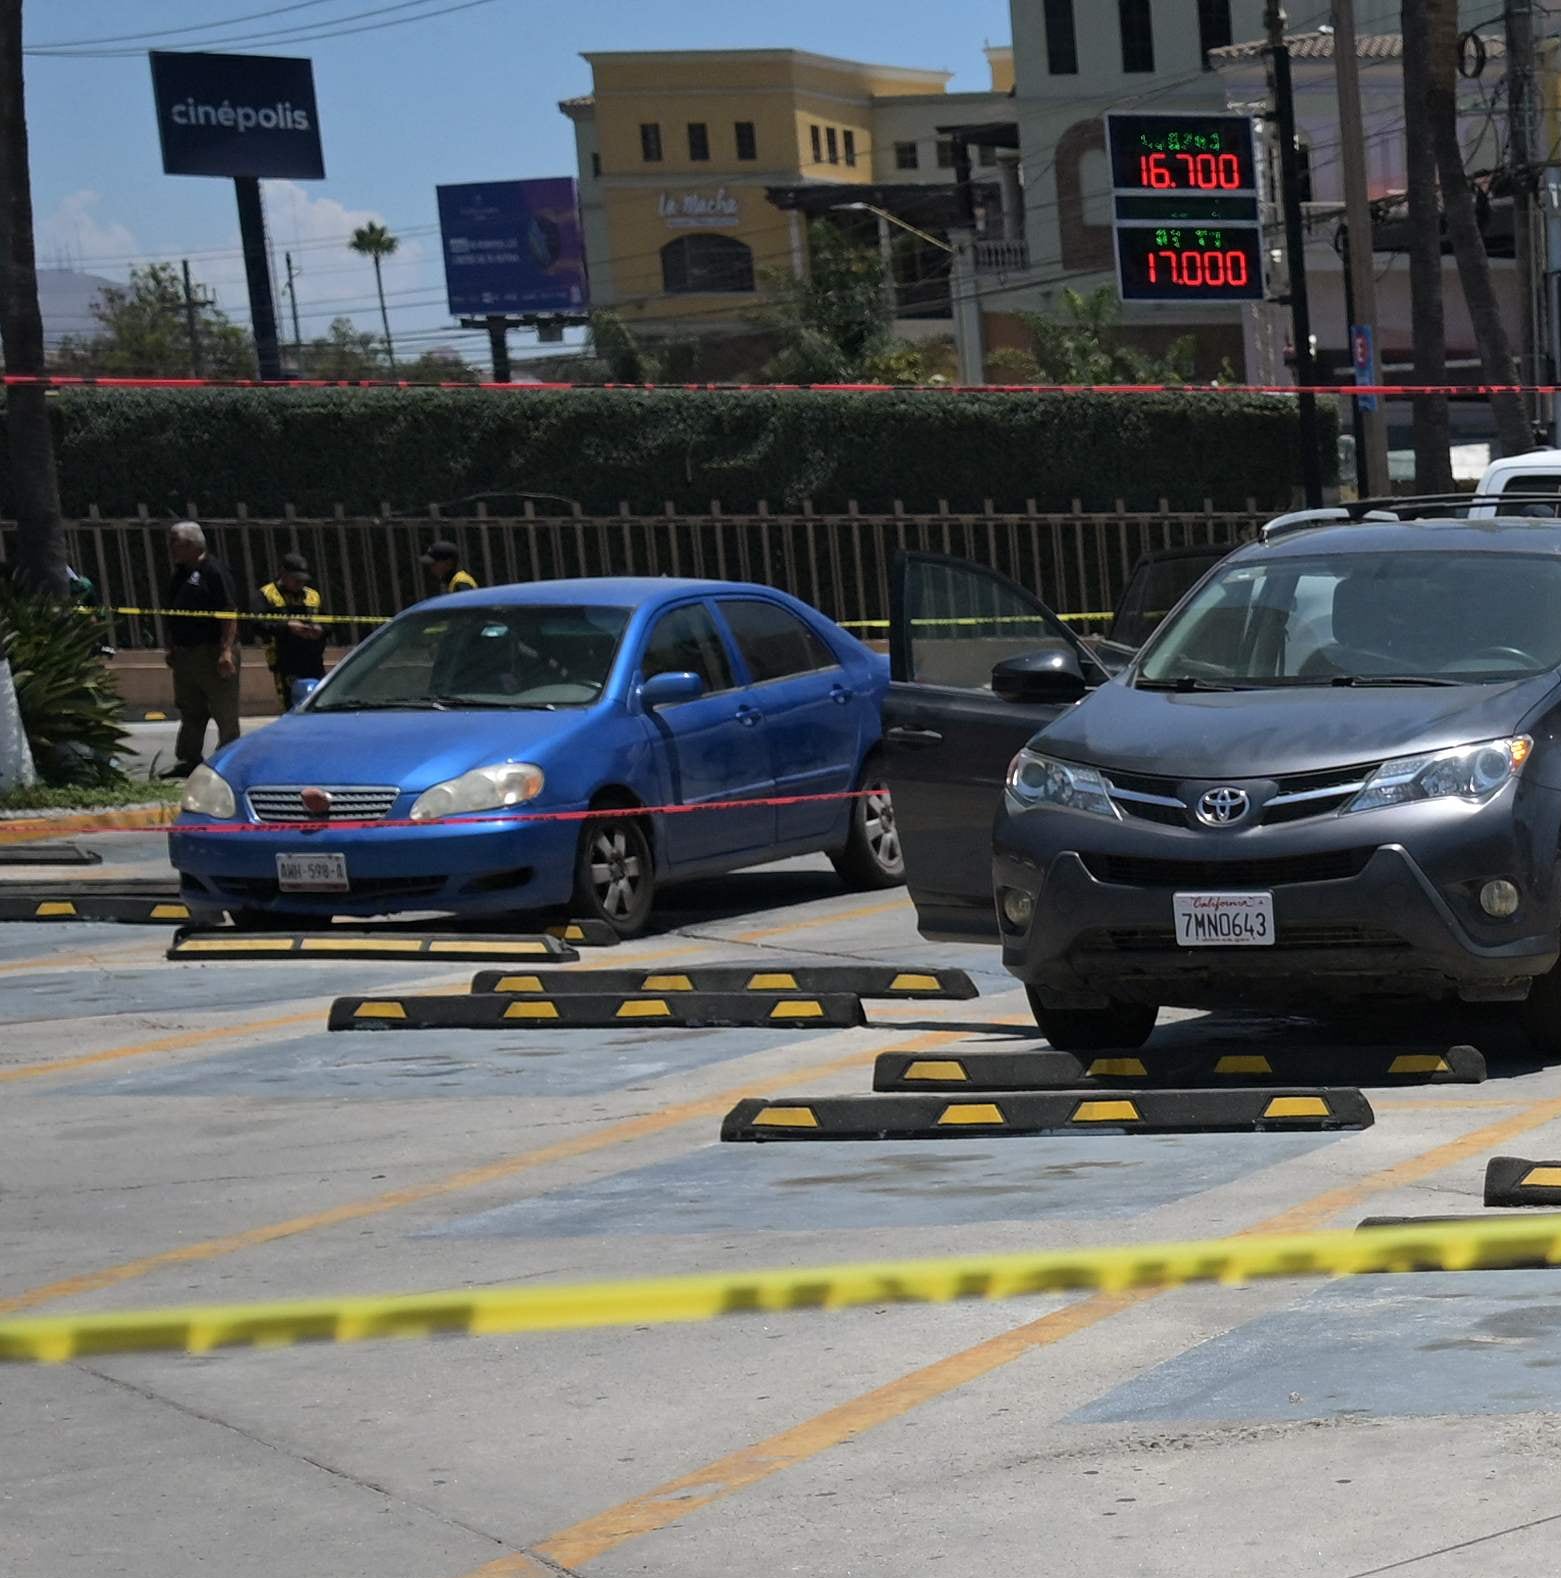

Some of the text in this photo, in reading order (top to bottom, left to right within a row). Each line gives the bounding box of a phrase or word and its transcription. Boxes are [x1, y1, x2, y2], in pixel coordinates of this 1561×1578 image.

[171, 97, 310, 132] cinépolis
[1140, 154, 1239, 189] 16.700
[1149, 251, 1248, 286] 17.000
[1192, 896, 1252, 911] California
